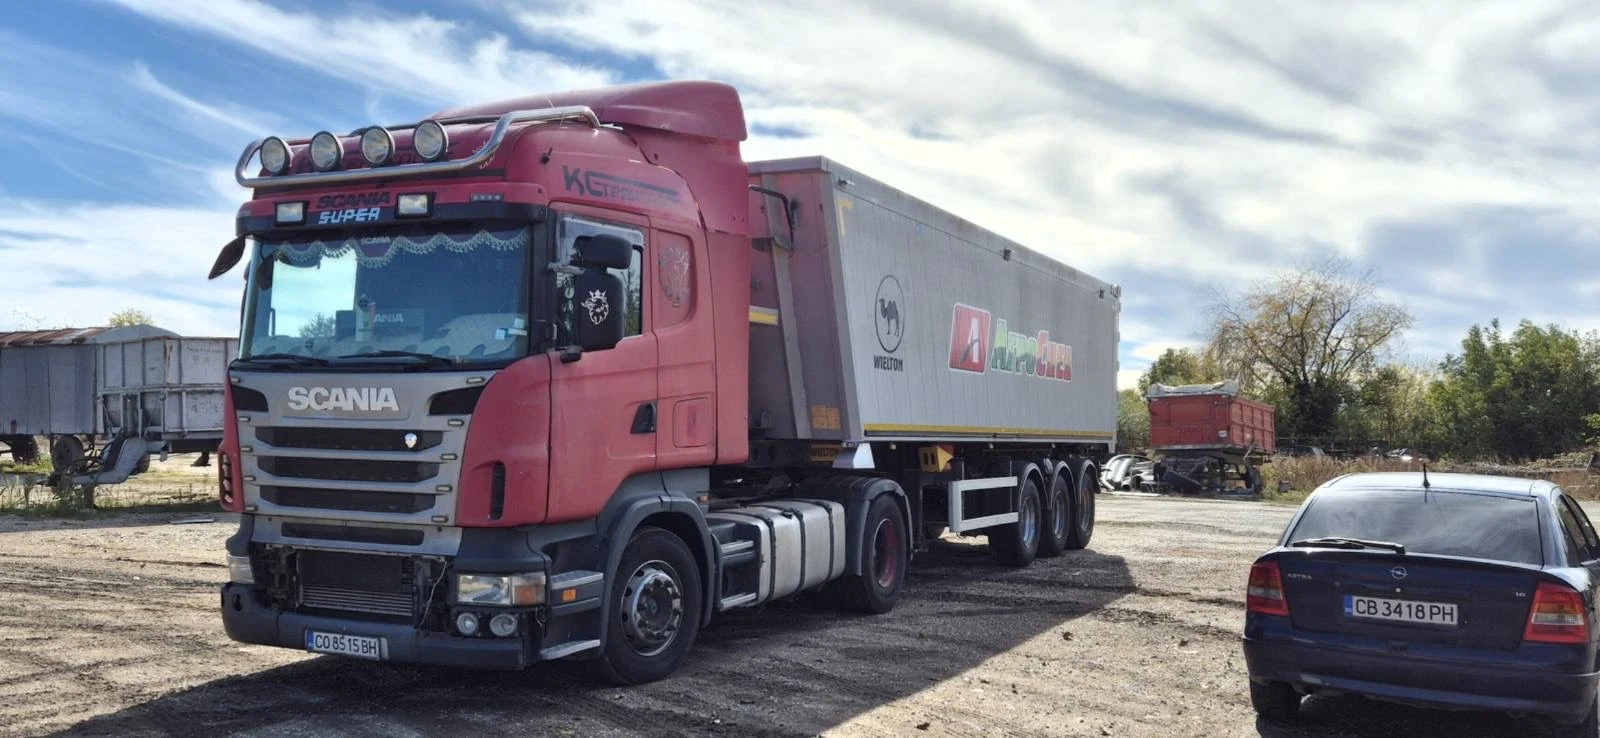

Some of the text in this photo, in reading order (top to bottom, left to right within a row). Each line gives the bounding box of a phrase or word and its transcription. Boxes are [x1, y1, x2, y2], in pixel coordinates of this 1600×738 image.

[316, 191, 390, 209] SCANIA
[318, 207, 381, 225] SUPER
[873, 354, 904, 372] WIELTON
[287, 386, 400, 412] SCANIA
[1355, 599, 1454, 622] CB 3418 PH
[332, 636, 360, 653] 8515
[361, 640, 377, 655] BH
